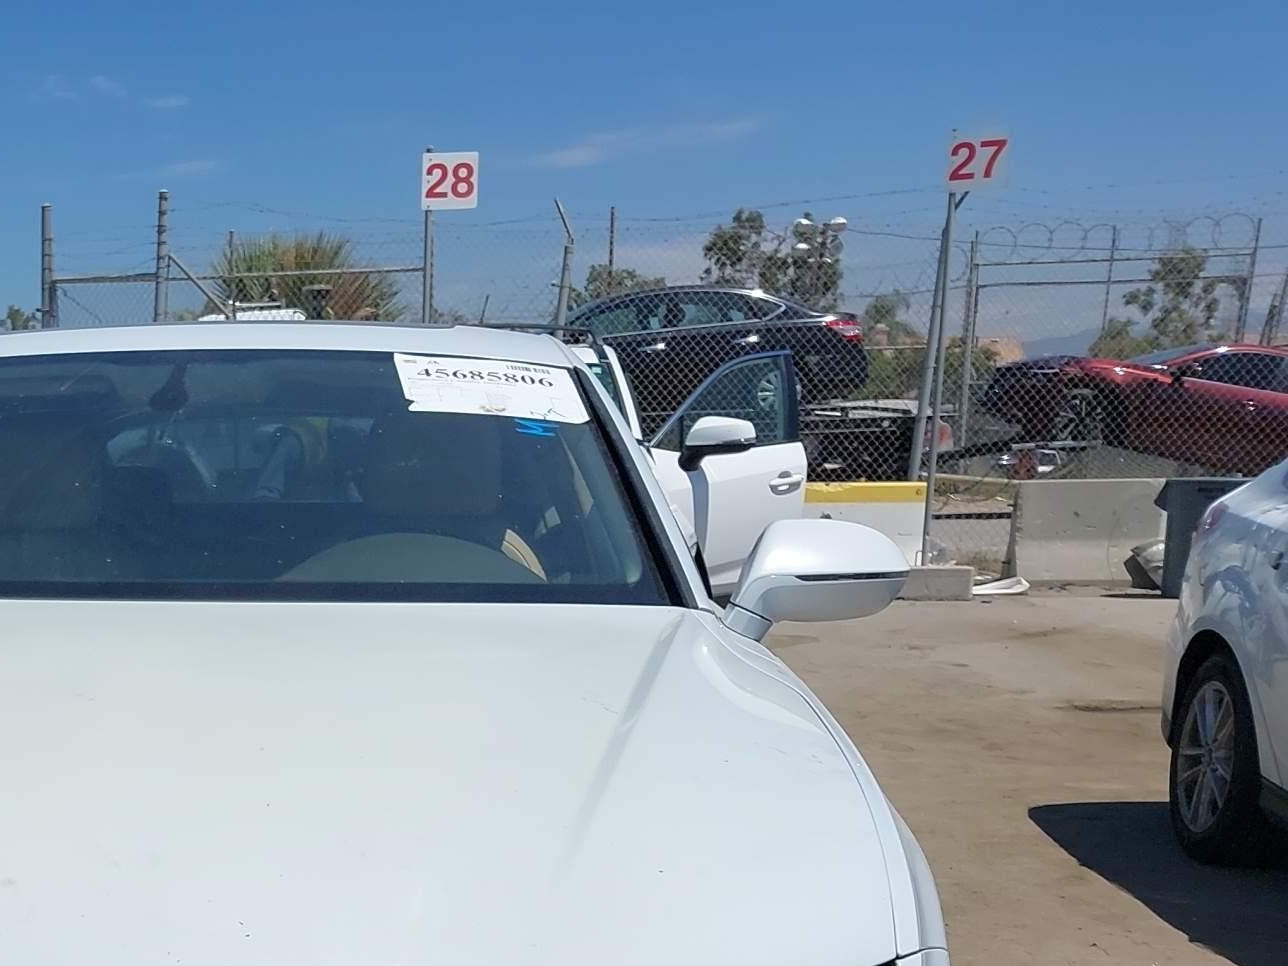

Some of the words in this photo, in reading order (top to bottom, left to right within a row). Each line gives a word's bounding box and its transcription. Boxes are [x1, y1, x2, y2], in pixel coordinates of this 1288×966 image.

[948, 138, 1009, 182] 27
[424, 162, 475, 199] 28
[416, 367, 555, 388] 45685806
